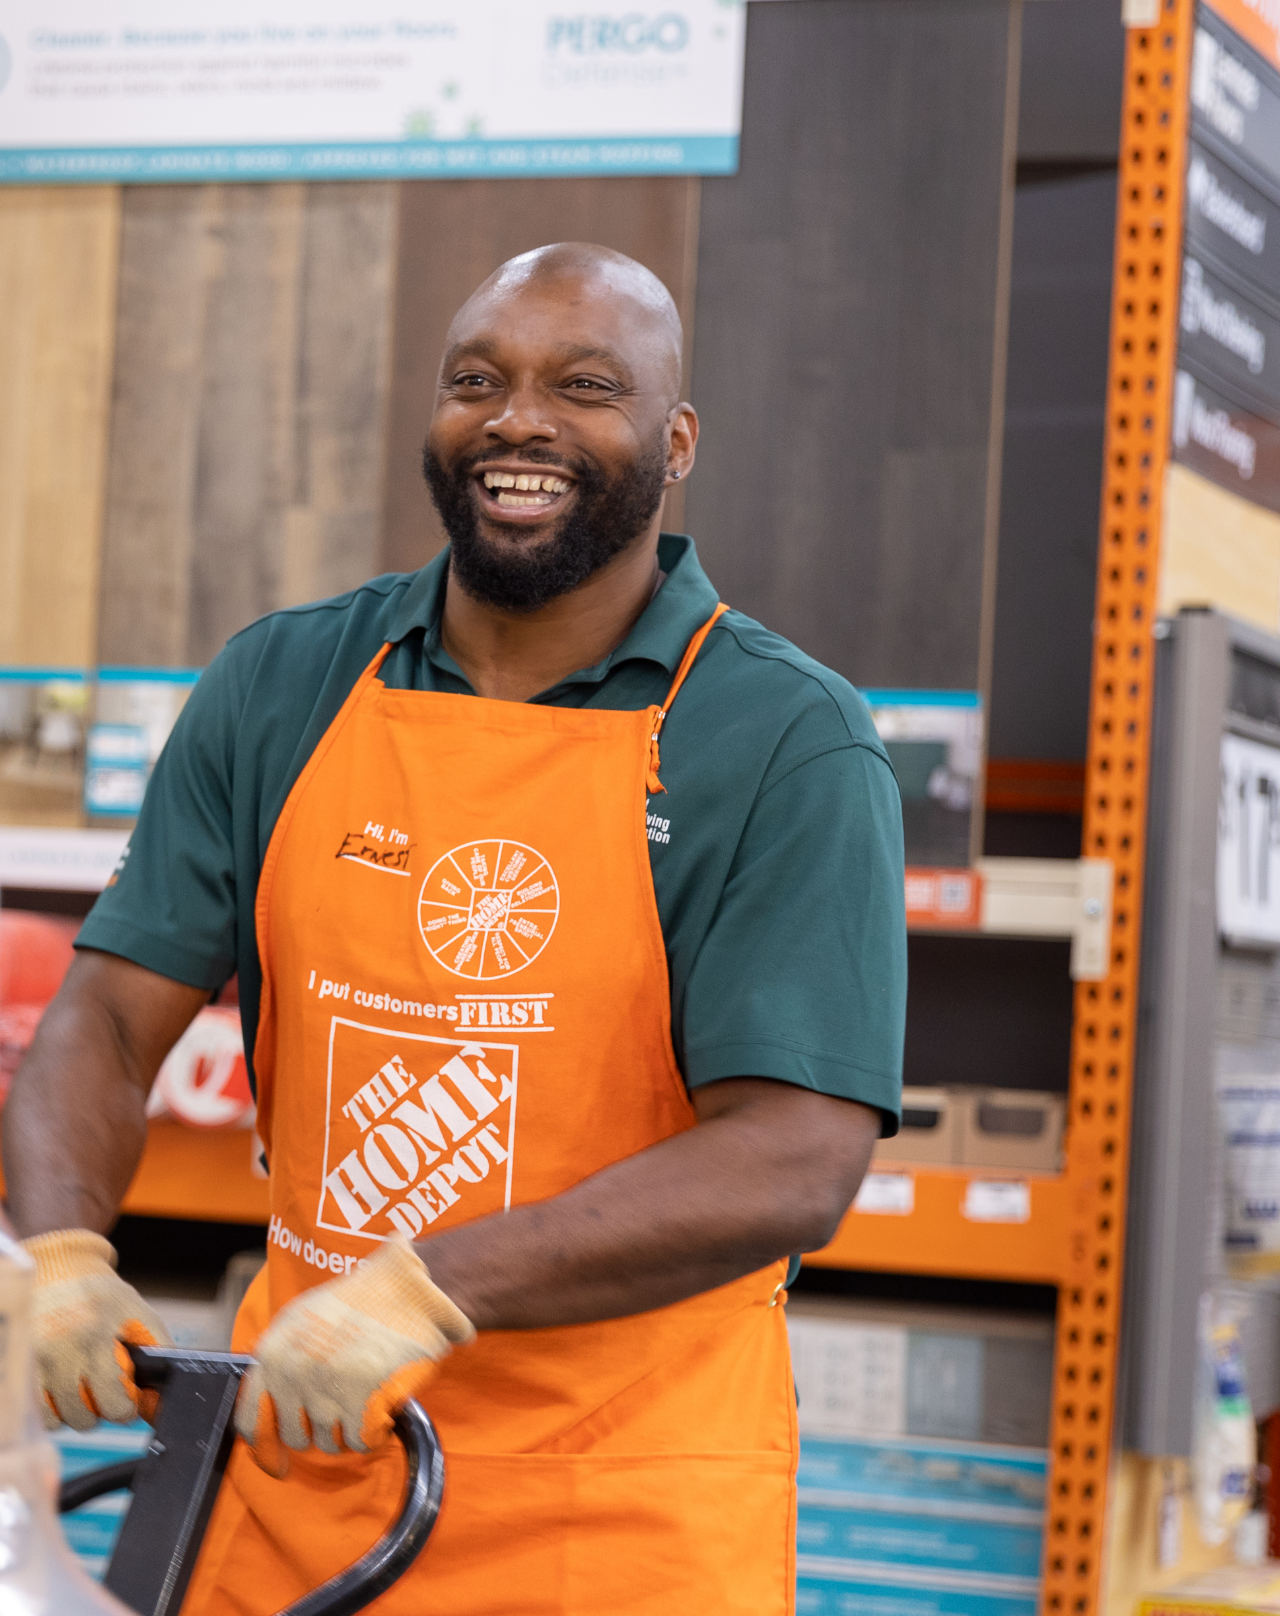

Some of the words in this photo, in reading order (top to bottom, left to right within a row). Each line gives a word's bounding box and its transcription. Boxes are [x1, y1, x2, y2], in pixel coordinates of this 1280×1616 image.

[547, 12, 691, 55] PERGO
[363, 821, 385, 842] Hi,
[388, 828, 409, 846] I'm
[646, 813, 671, 832] ving
[646, 827, 671, 844] tion
[335, 832, 418, 870] Ernest
[470, 892, 508, 929] HOME
[475, 894, 493, 910] THE
[483, 904, 508, 929] DEPOT
[308, 970, 316, 989] I
[318, 978, 350, 1000] put
[354, 989, 458, 1022] customers
[459, 1001, 548, 1026] FIRST
[342, 1054, 418, 1133] THE
[325, 1046, 513, 1231] HOME
[385, 1122, 509, 1240] DEPOT
[268, 1214, 302, 1257] How
